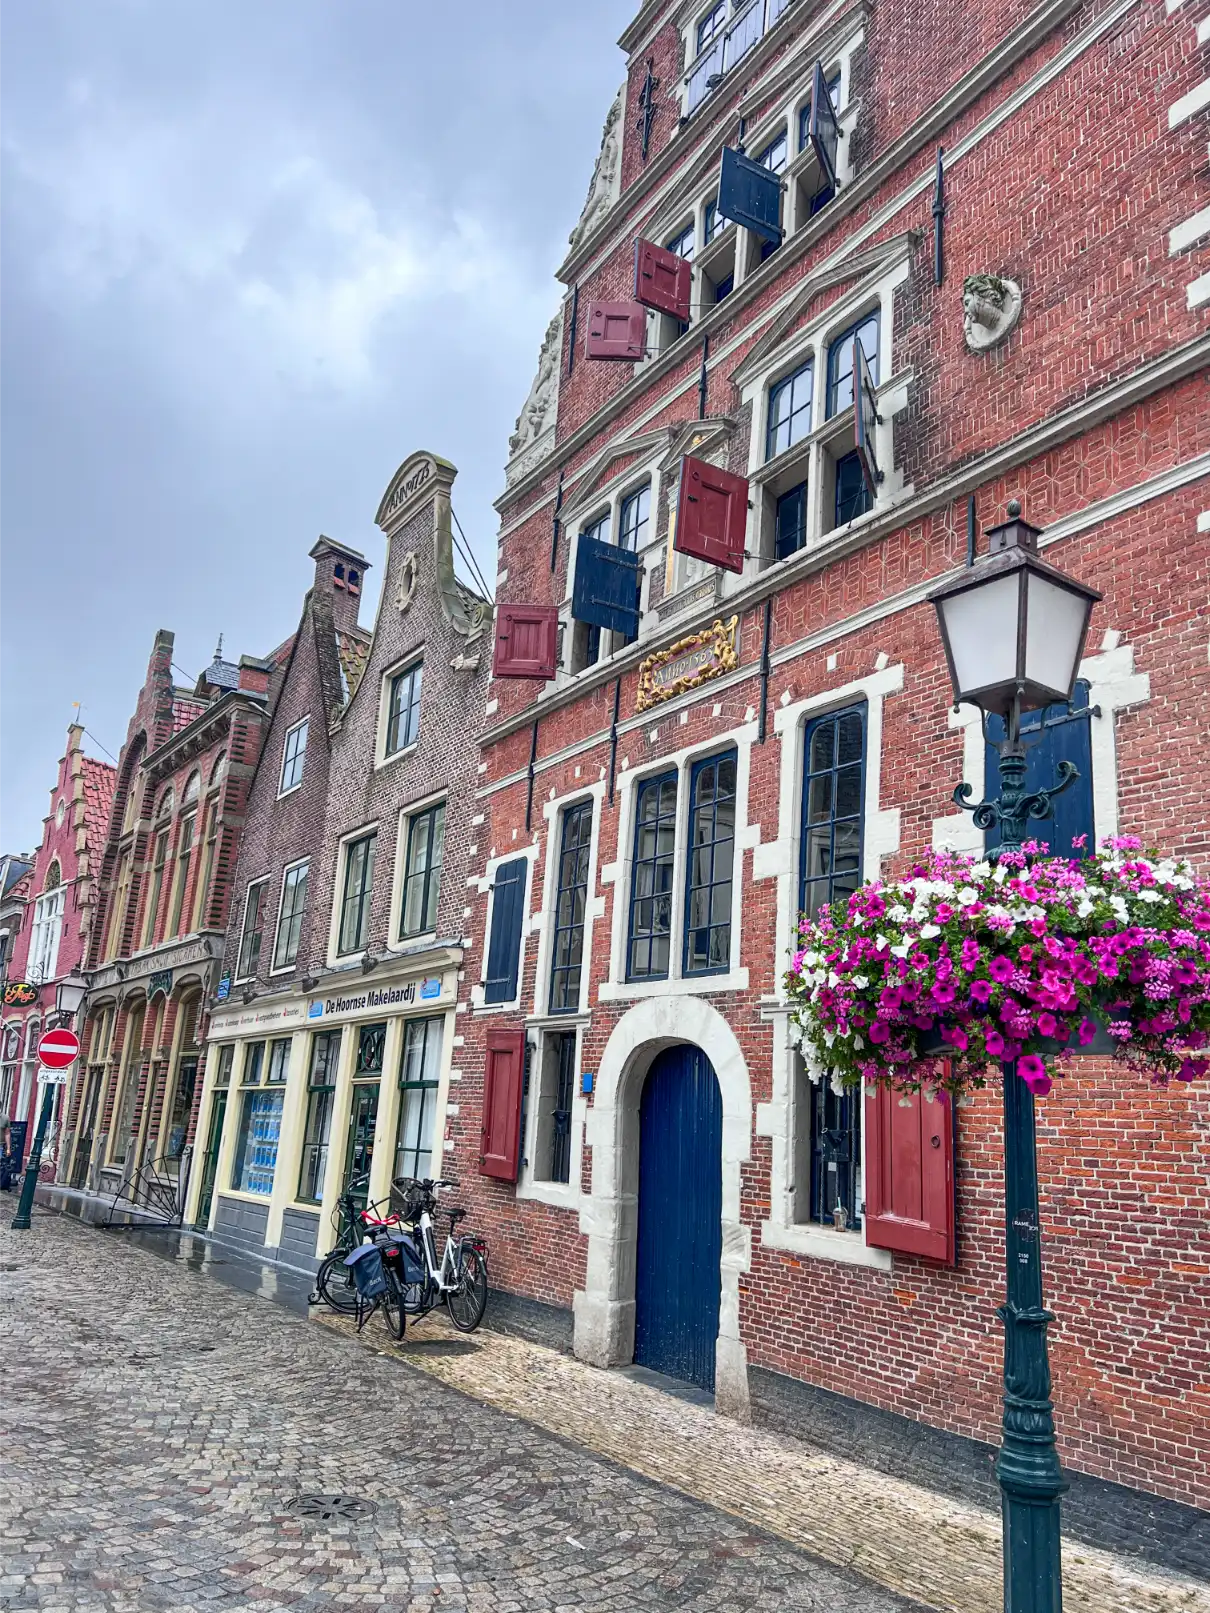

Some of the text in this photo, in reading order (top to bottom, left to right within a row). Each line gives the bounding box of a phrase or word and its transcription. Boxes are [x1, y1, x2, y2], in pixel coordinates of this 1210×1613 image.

[325, 999, 335, 1014] De
[335, 996, 366, 1012] Hoornse
[366, 983, 416, 1007] Makelaardij
